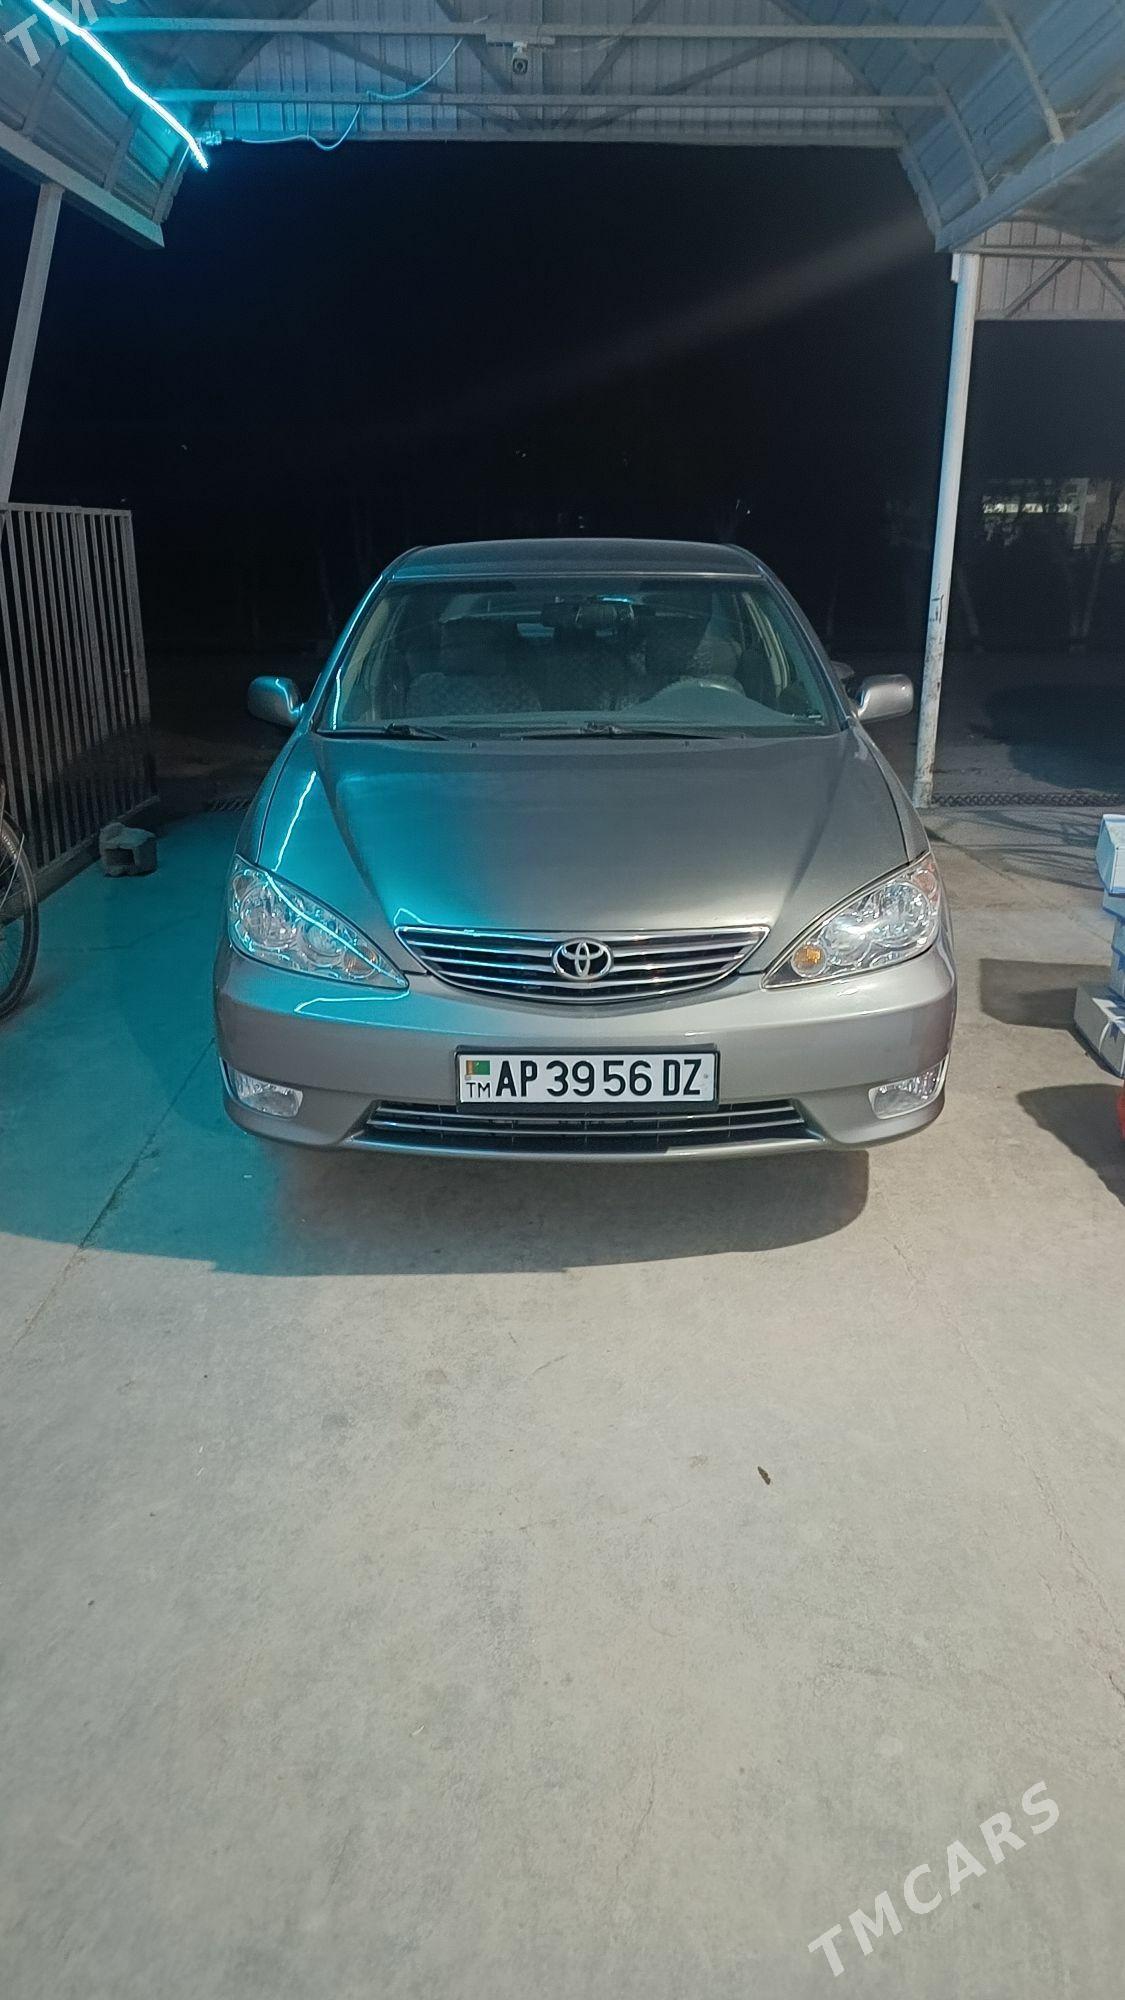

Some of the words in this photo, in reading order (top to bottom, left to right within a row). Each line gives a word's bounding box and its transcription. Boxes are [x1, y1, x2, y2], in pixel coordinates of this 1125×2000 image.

[465, 1082, 490, 1098] TM
[495, 1060, 538, 1097] AP
[662, 1059, 702, 1097] DZ
